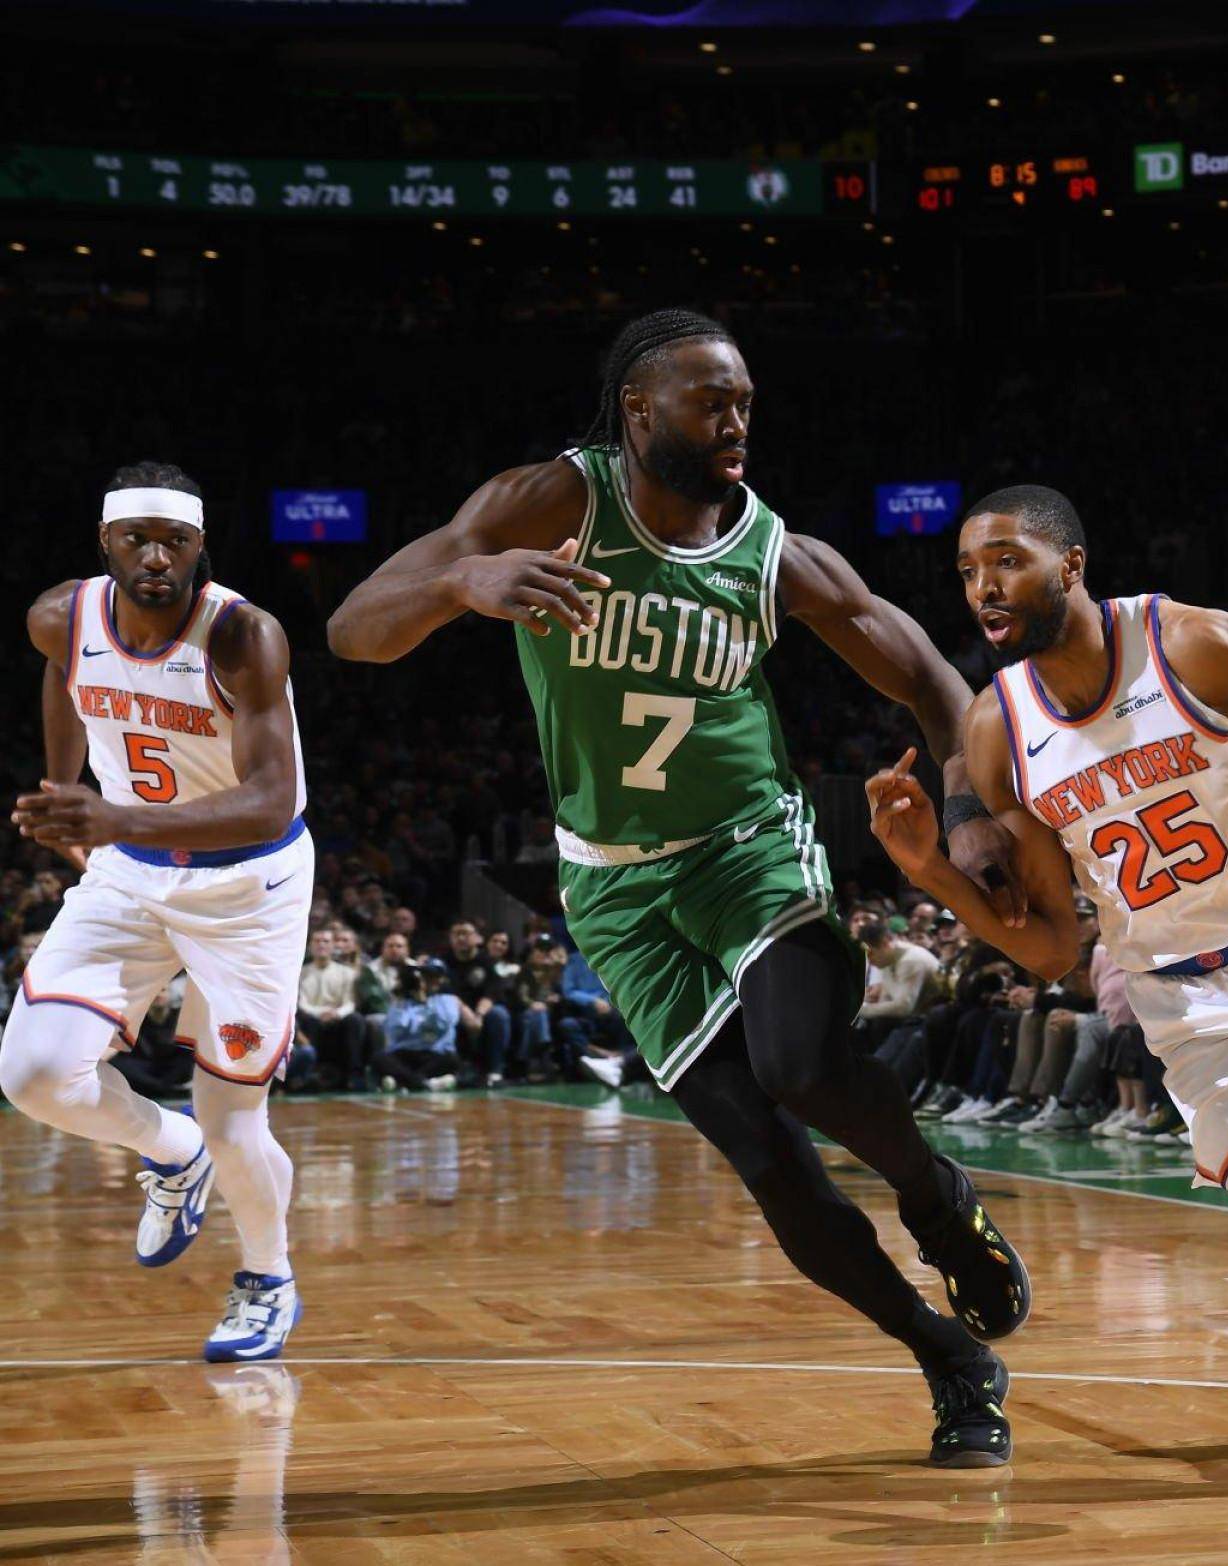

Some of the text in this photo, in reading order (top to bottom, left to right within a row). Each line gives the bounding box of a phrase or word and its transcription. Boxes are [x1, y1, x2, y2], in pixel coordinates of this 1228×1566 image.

[834, 170, 866, 200] 10
[1139, 152, 1178, 182] TD
[107, 175, 120, 200] 1
[160, 179, 178, 201] 4
[283, 184, 352, 208] 39/78
[389, 185, 456, 208] 14/34
[491, 185, 509, 208] 9
[553, 185, 570, 209] 6
[608, 186, 637, 209] 24
[669, 186, 697, 209] 41
[285, 503, 351, 521] ULTRA
[888, 496, 947, 514] ULTRA
[705, 571, 757, 594] Amica
[569, 590, 758, 692] BOSTON
[77, 685, 218, 738] NEW YORK
[621, 691, 697, 792] 7
[122, 732, 178, 803] 5
[1033, 731, 1210, 831] NEW YORK
[1089, 789, 1228, 912] 25
